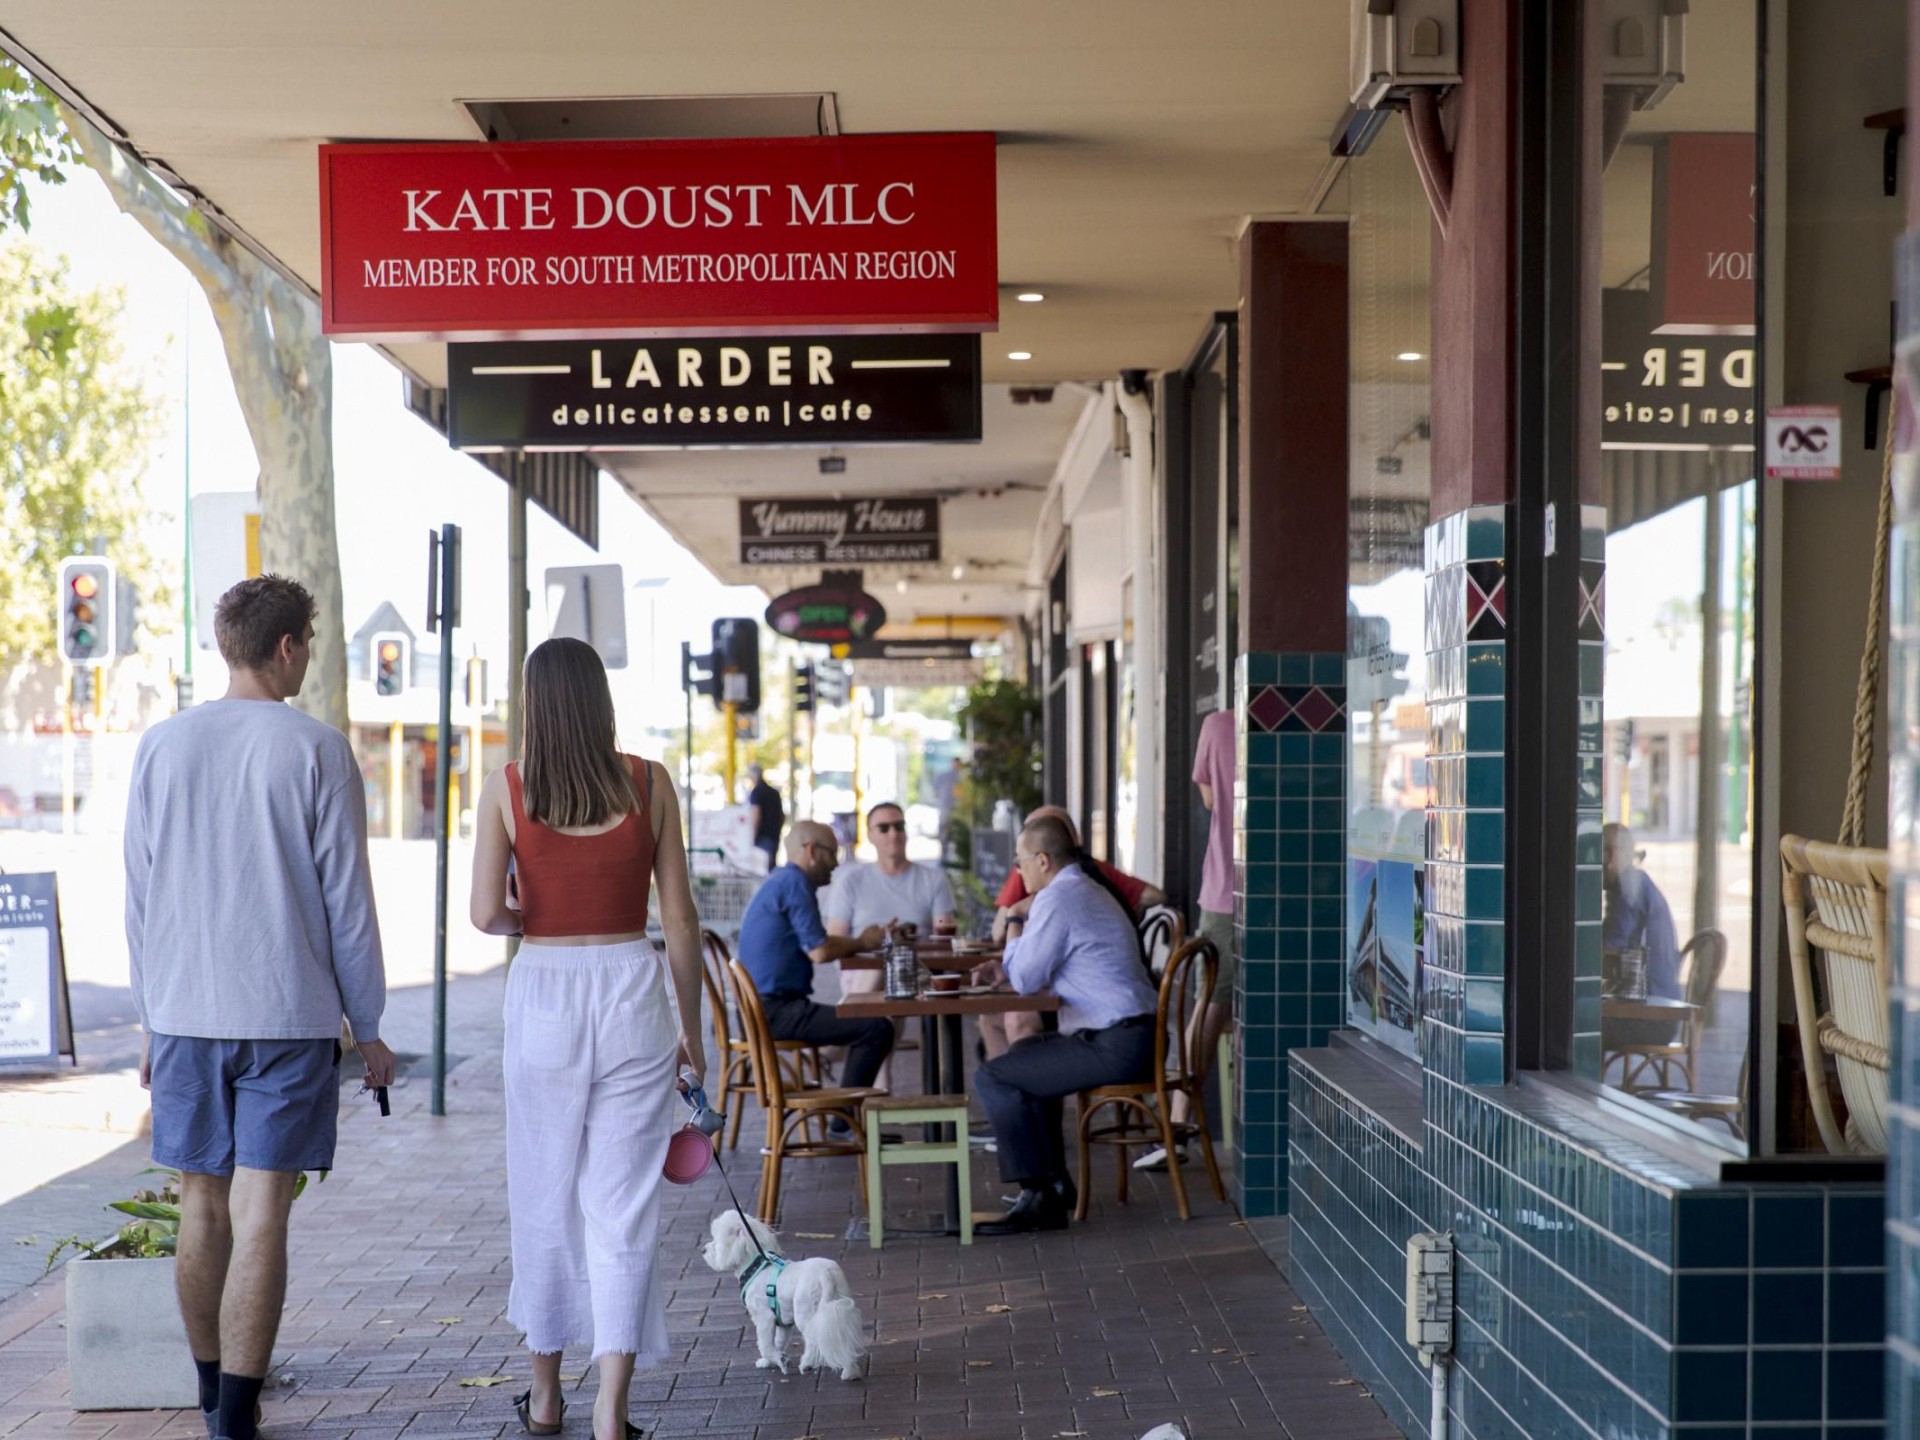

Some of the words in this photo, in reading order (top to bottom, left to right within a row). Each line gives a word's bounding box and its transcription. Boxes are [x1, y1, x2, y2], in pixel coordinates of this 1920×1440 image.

[402, 188, 555, 232] KATE
[571, 185, 771, 229] DOUST
[787, 182, 915, 226] MLC
[363, 258, 480, 288] MEMBER
[486, 257, 538, 286] FOR
[545, 255, 634, 285] SOUTH
[641, 252, 847, 283] METROPOLITAN
[855, 250, 955, 280] REGION
[591, 346, 835, 389] LARDER
[552, 403, 770, 426] delicatessen
[752, 502, 847, 548] Yummy
[854, 502, 926, 531] House
[746, 546, 818, 563] CHINESE
[825, 545, 930, 562] RESTAURANT
